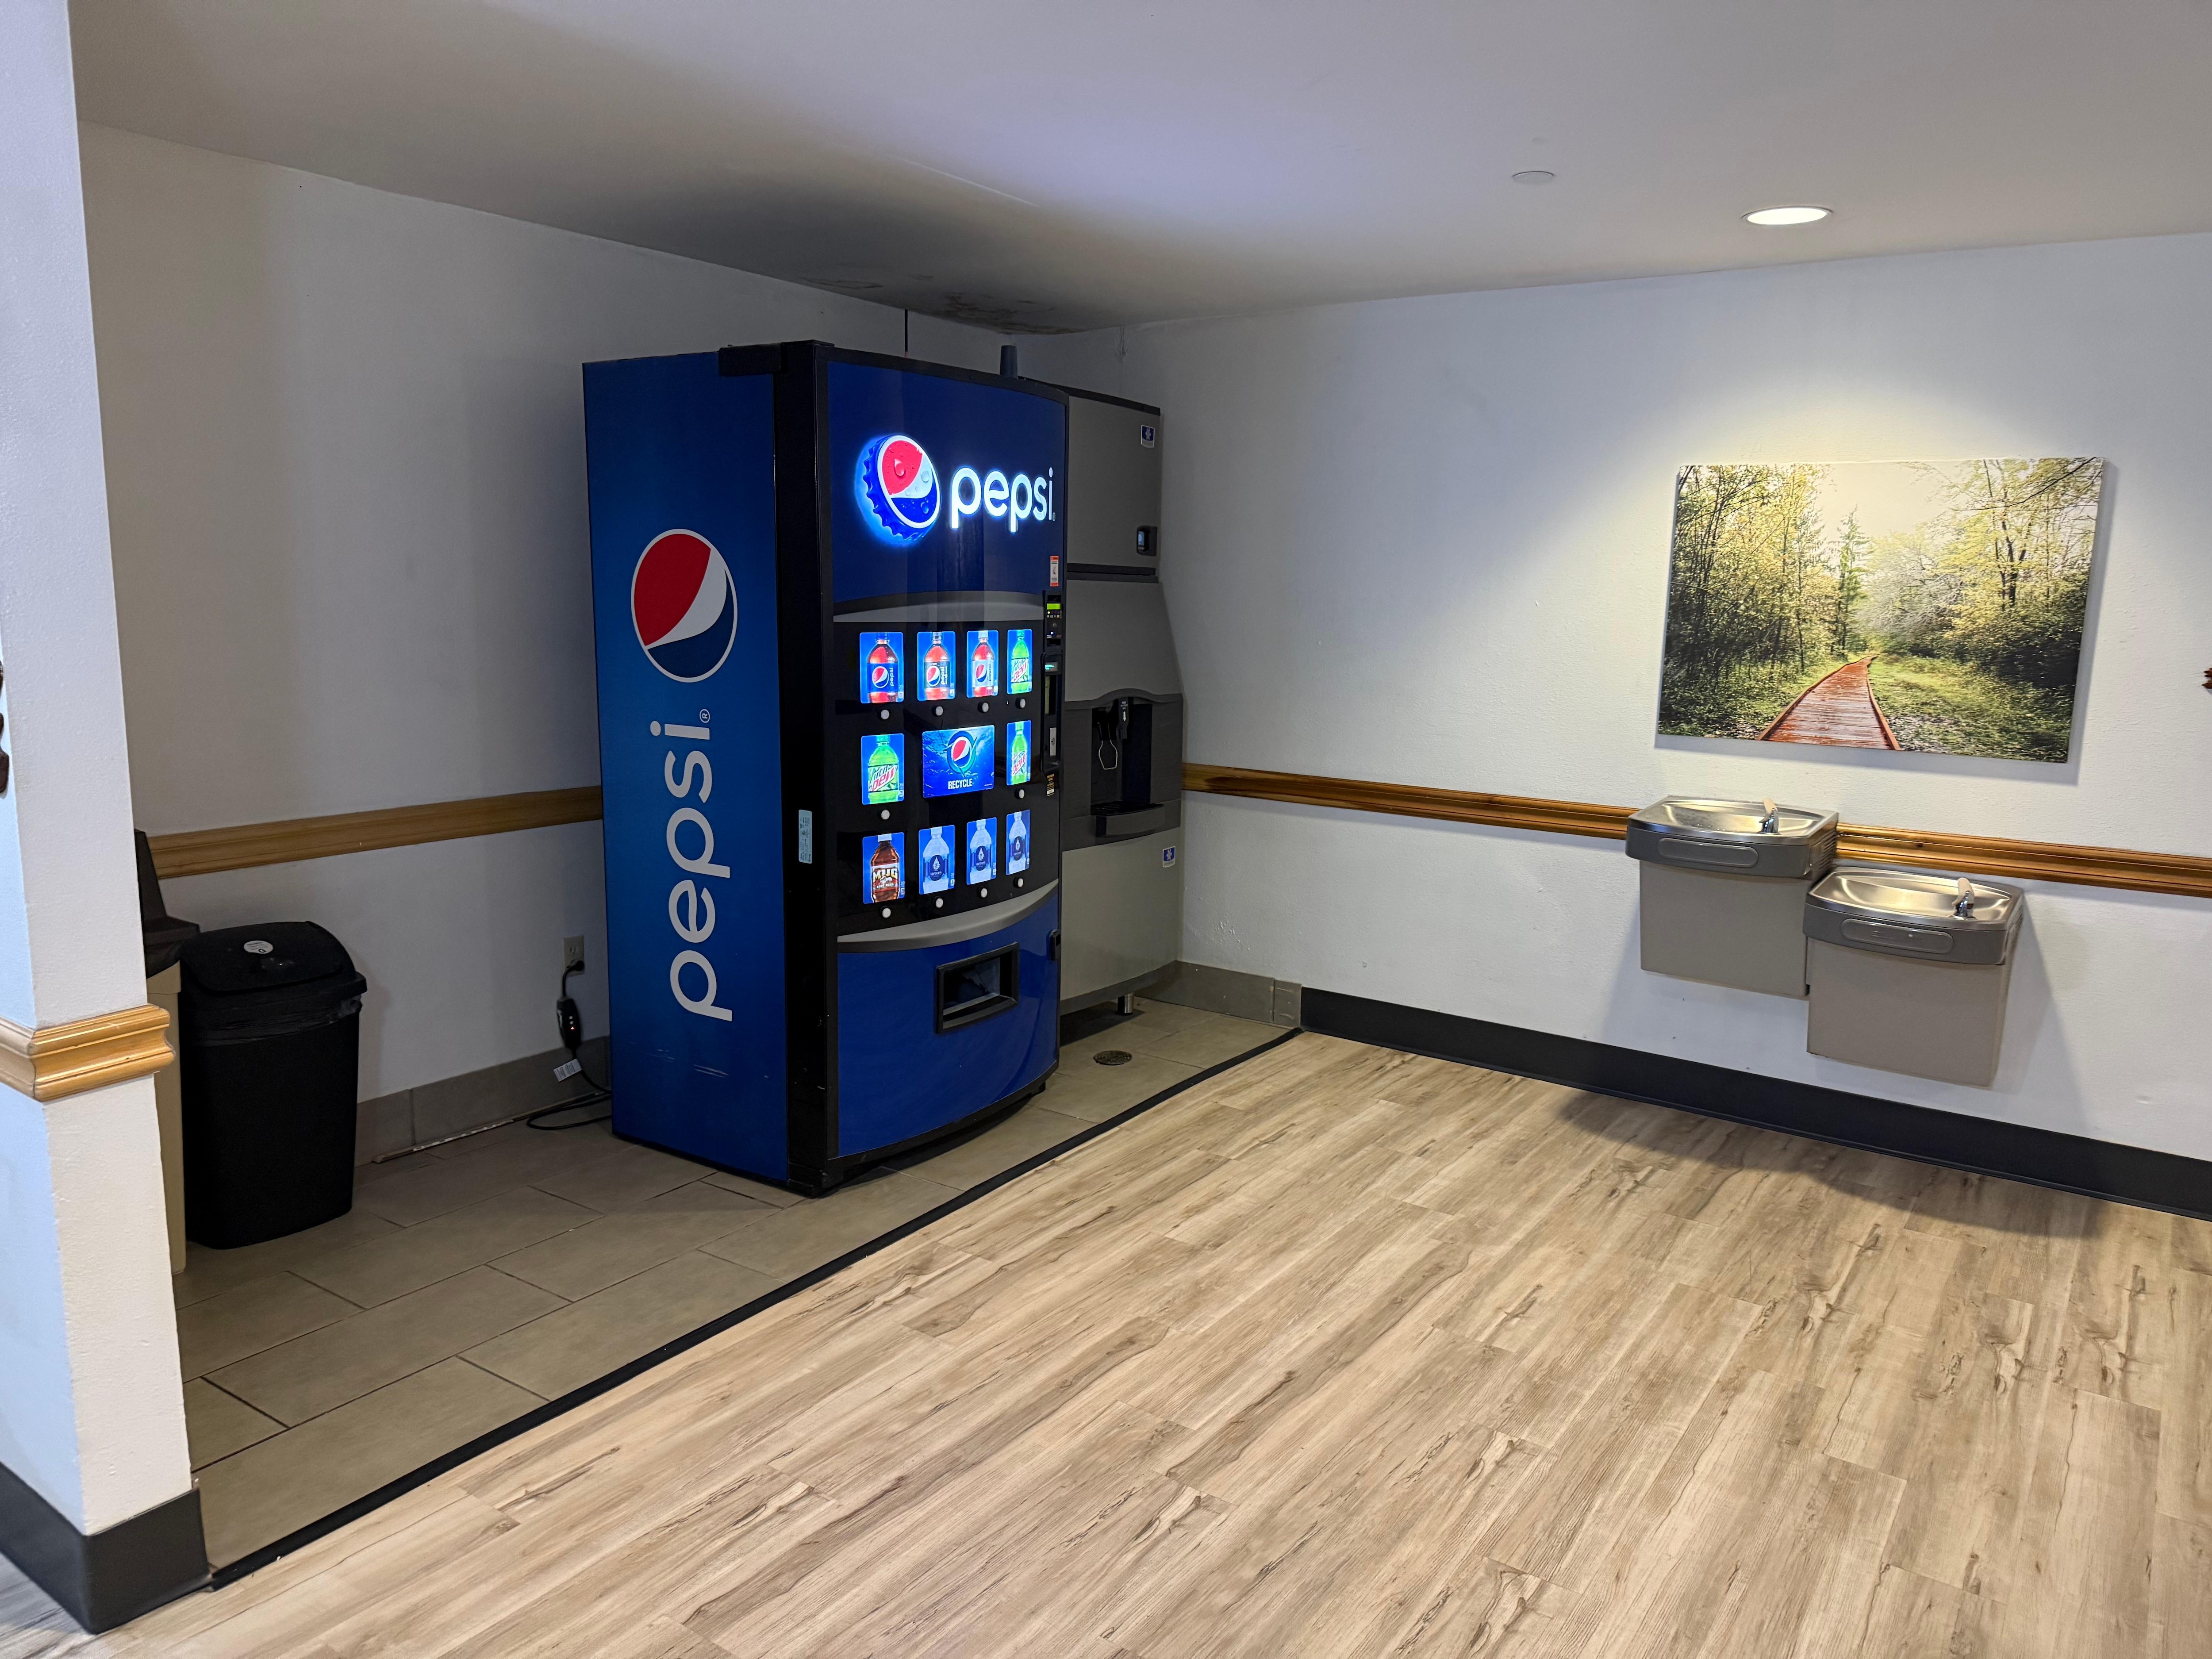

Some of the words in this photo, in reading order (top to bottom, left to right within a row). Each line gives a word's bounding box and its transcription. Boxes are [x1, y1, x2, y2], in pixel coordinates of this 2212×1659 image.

[952, 467, 1052, 532] pepsi
[948, 778, 972, 789] RECYCLE
[650, 721, 732, 1022] pepsi
[873, 868, 898, 883] MUG
